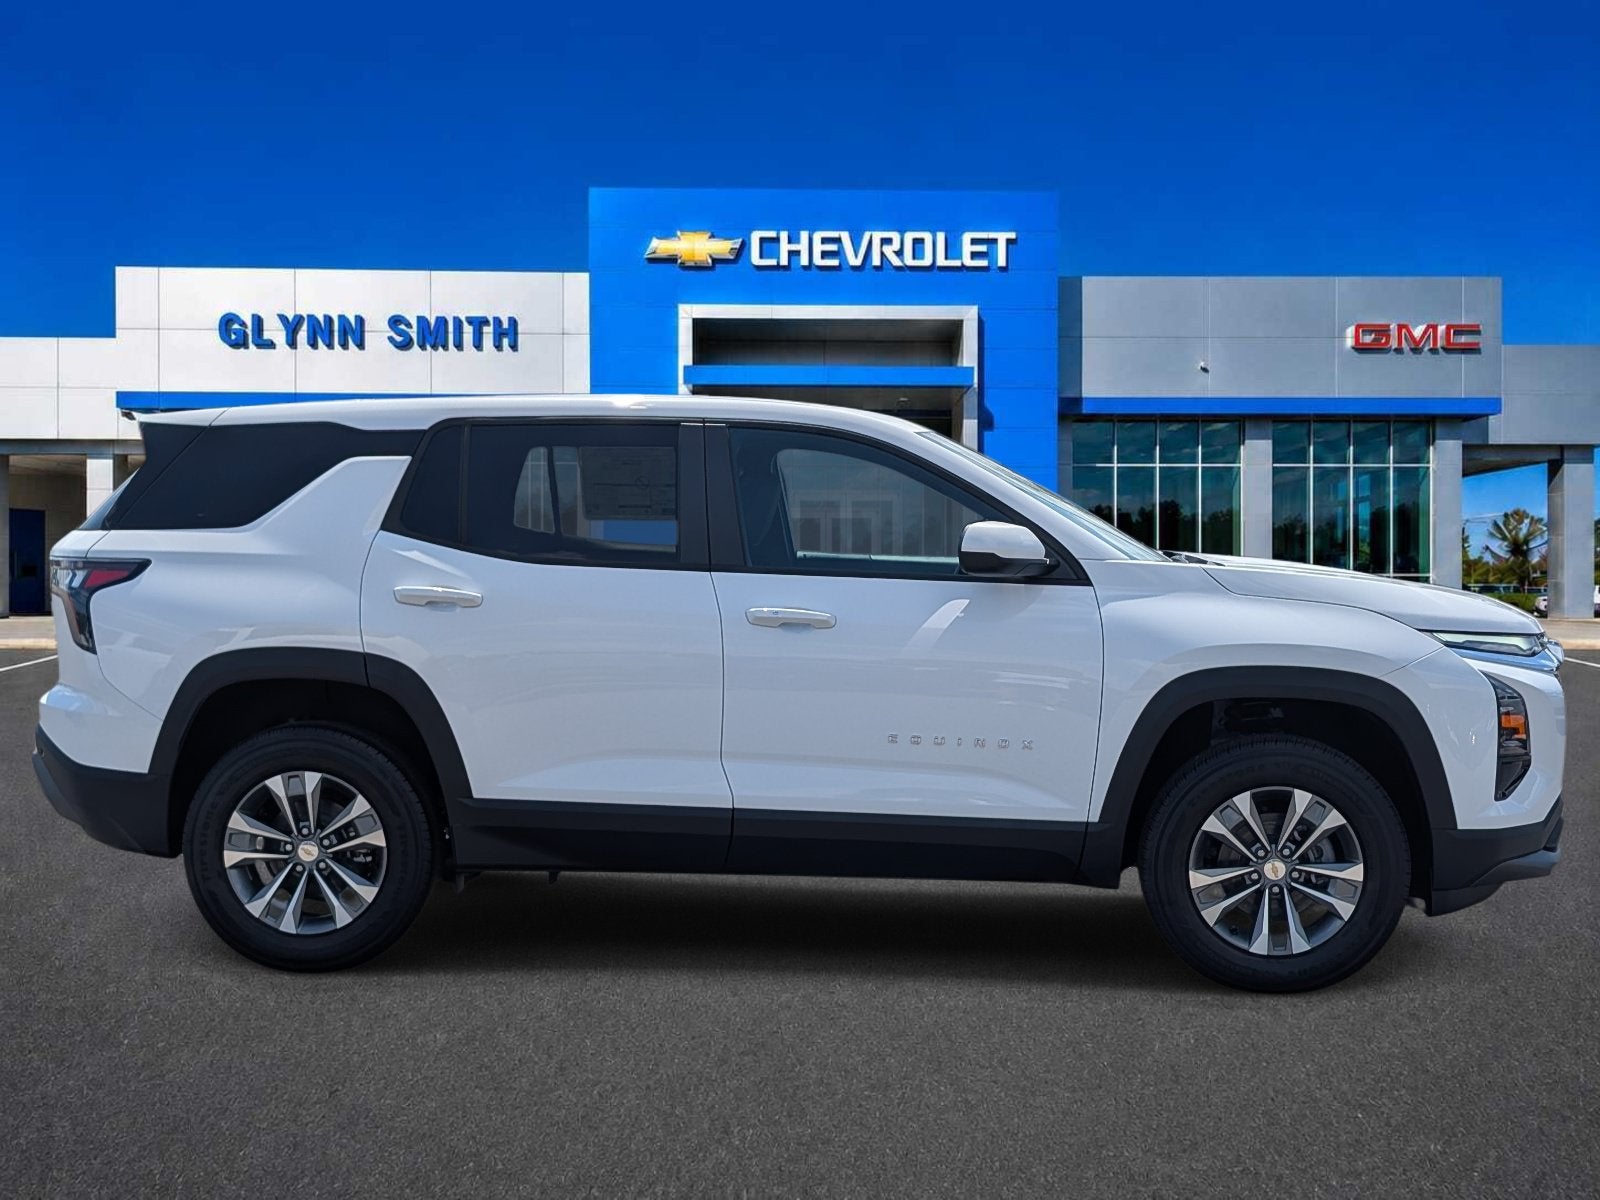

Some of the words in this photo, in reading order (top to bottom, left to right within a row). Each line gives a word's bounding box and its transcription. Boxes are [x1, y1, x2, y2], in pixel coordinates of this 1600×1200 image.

[750, 230, 1017, 269] CHEVROLET
[218, 312, 366, 351] GLYNN
[386, 314, 519, 352] SMITH
[1348, 322, 1483, 353] GMC
[887, 733, 1035, 751] EQUINOX
